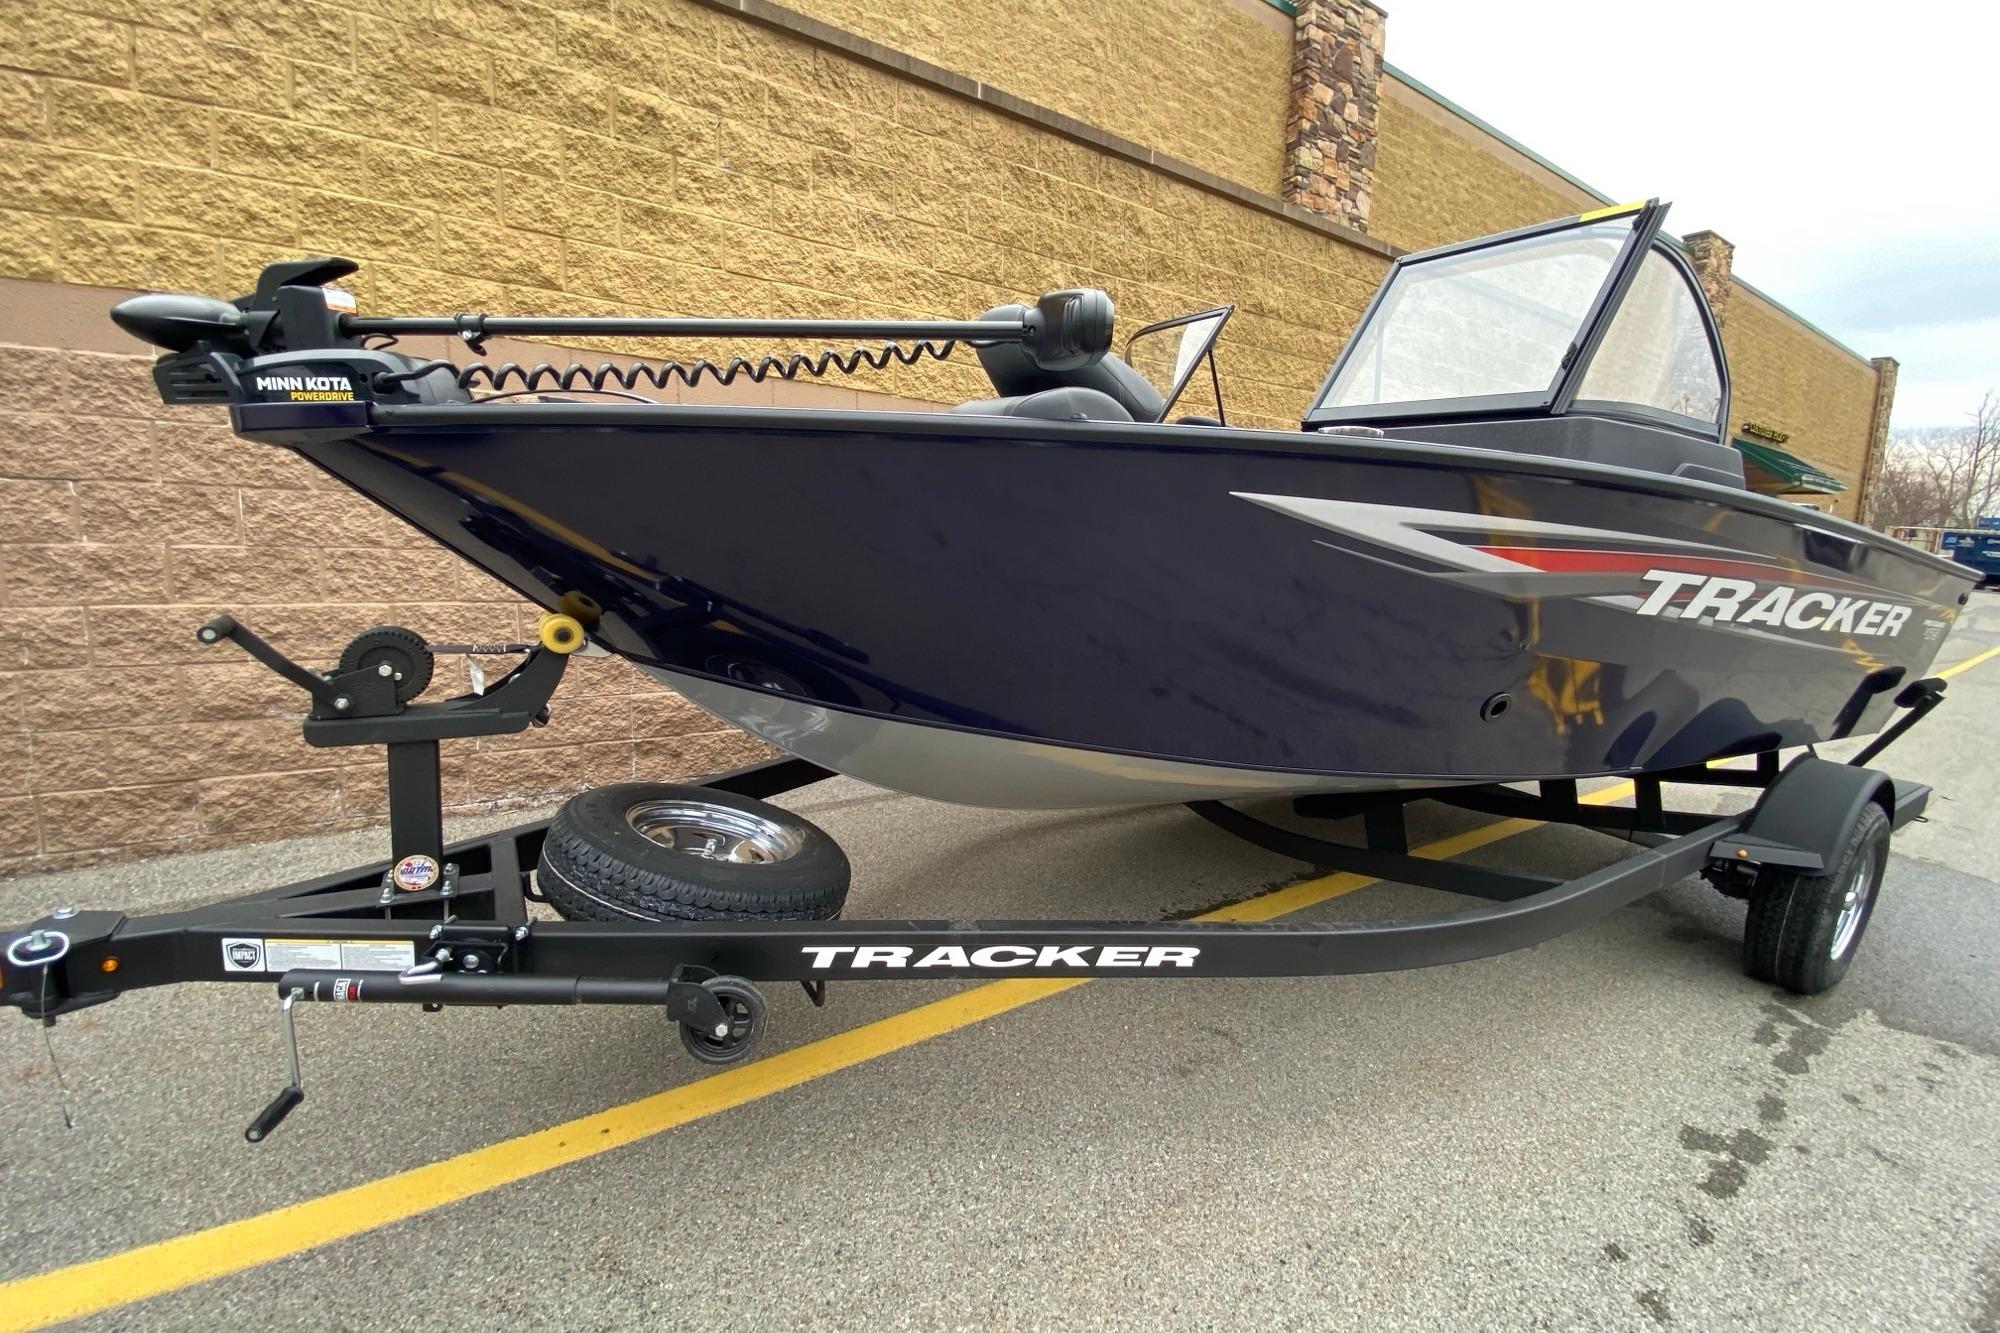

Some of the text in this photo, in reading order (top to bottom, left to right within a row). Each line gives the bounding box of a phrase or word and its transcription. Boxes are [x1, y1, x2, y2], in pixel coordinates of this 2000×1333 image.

[256, 376, 353, 391] MINN KOTA
[290, 391, 354, 401] POWERDRIVE
[1636, 569, 1912, 637] TRACKER
[801, 945, 1201, 968] TRACKER
